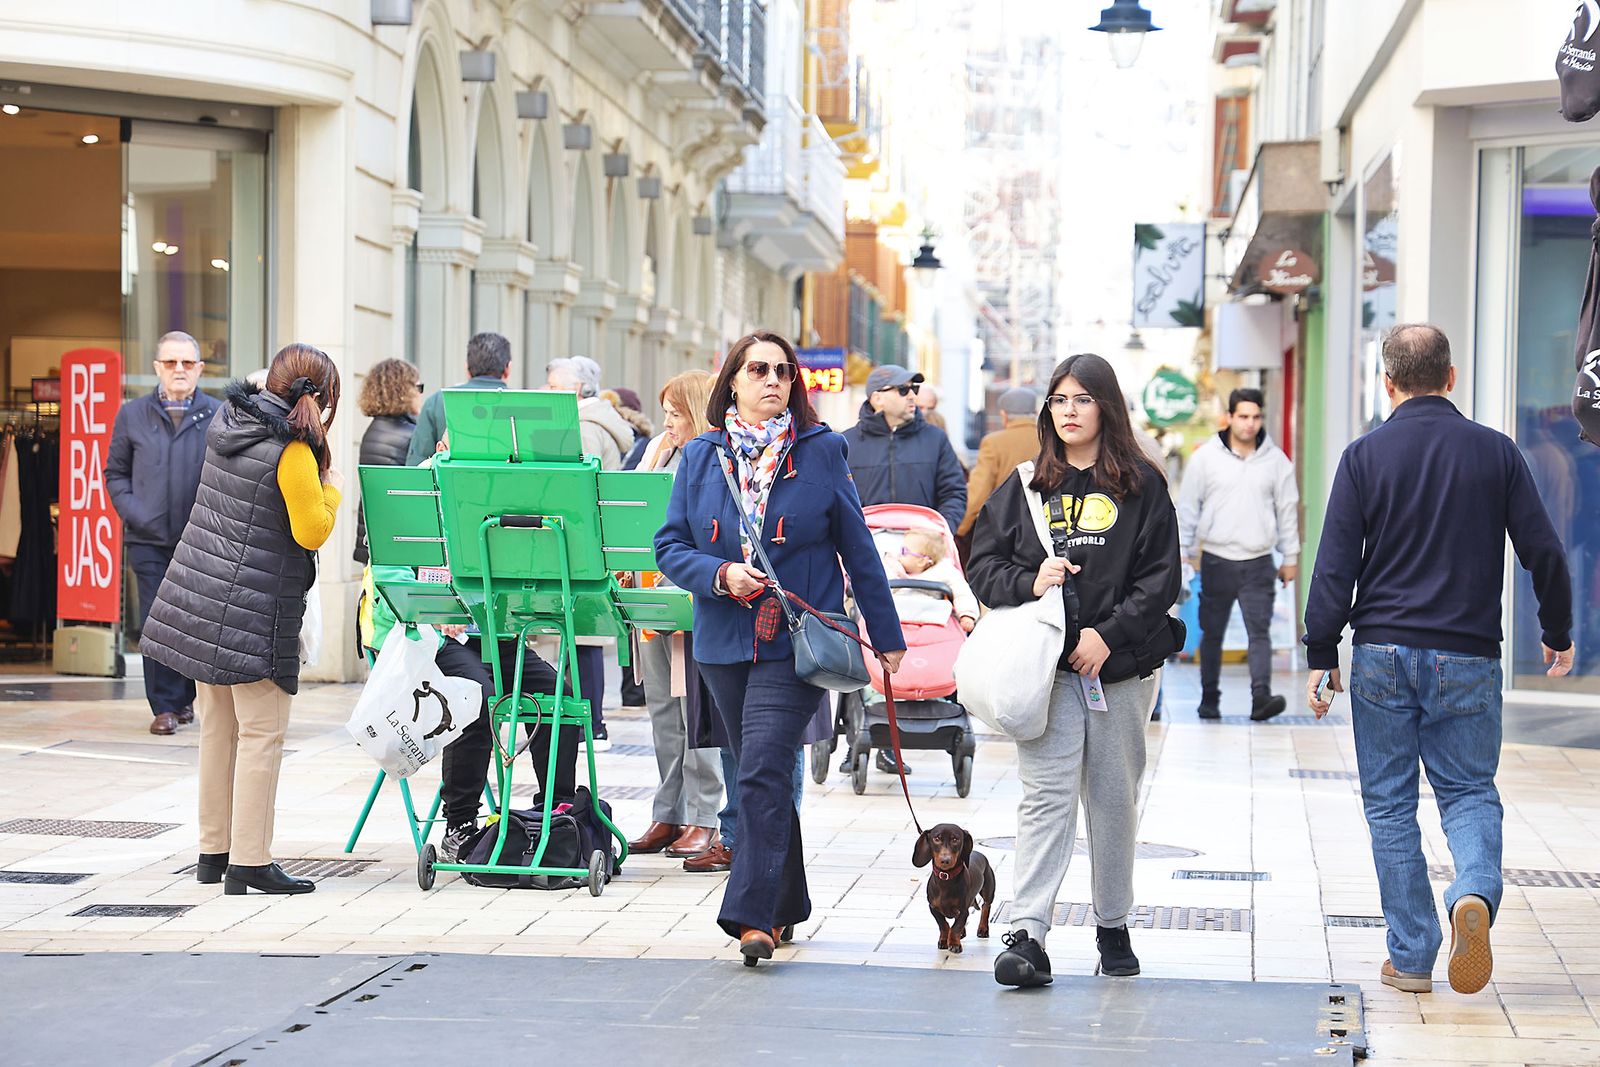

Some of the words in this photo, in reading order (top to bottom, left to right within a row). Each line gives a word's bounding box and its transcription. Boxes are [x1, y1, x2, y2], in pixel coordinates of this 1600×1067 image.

[70, 363, 107, 434] RE
[1576, 386, 1591, 399] La
[70, 439, 107, 511] BA
[64, 515, 113, 589] JAS
[1066, 535, 1106, 549] EYWORLD
[385, 710, 400, 728] La
